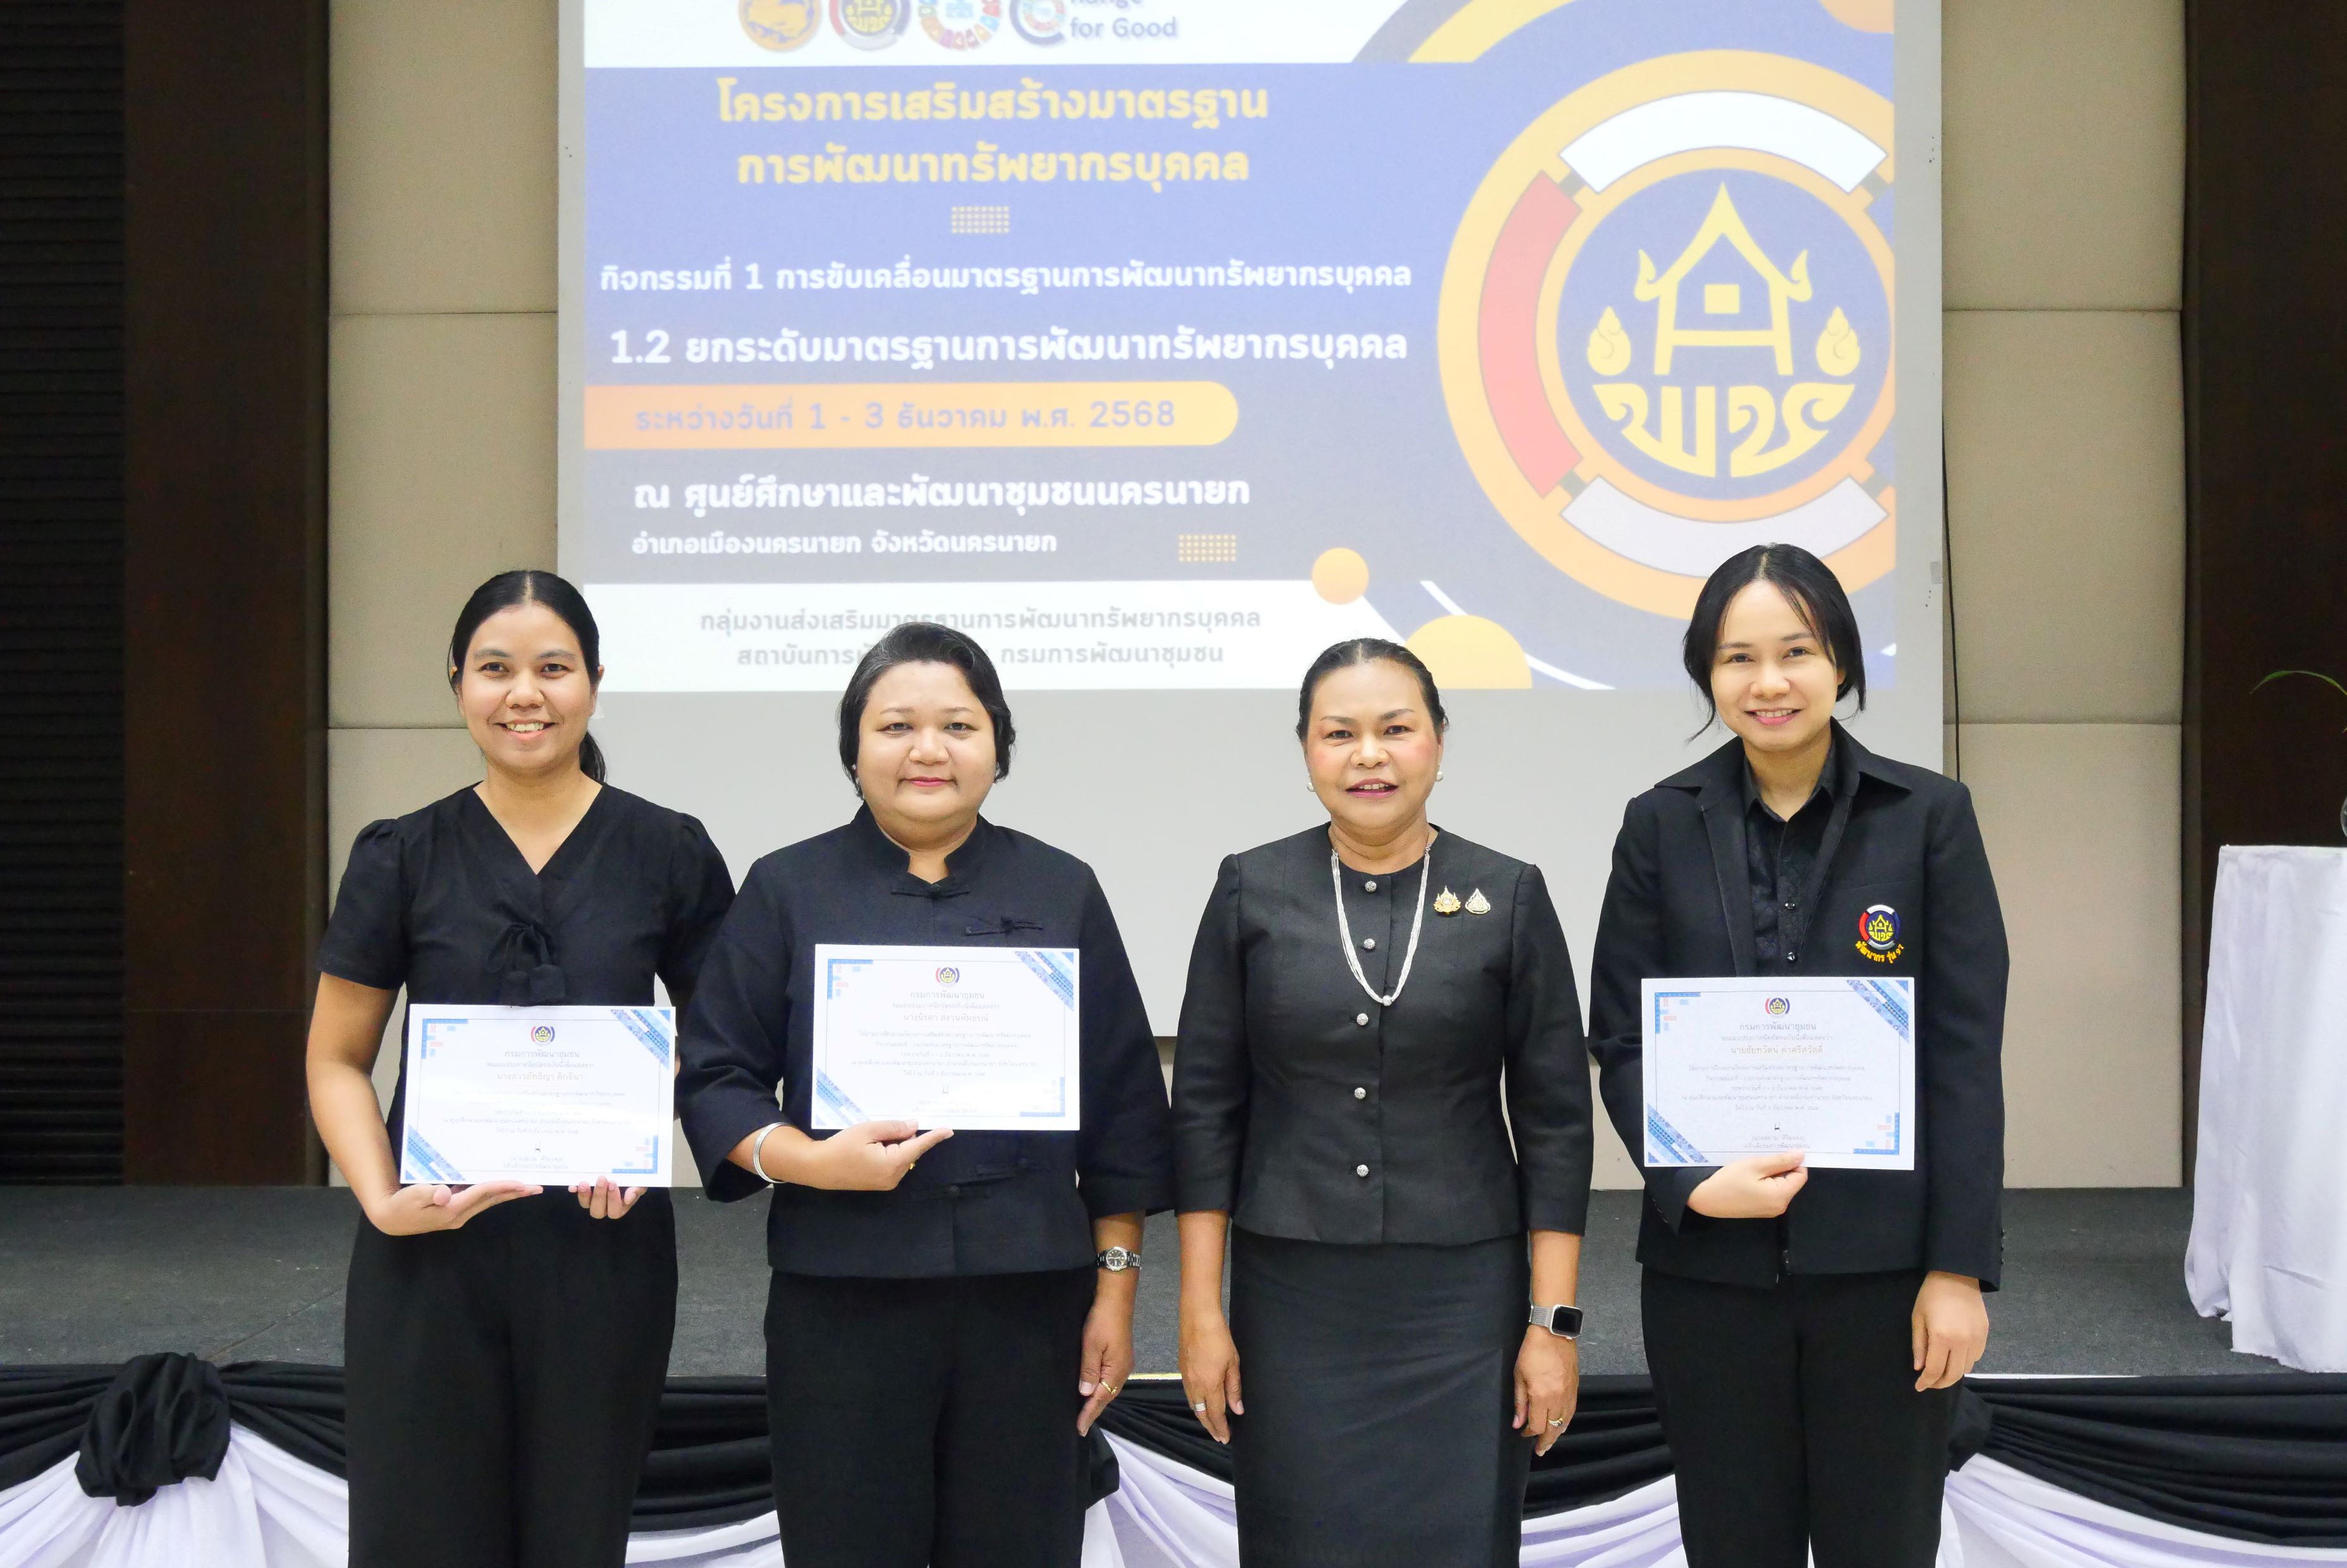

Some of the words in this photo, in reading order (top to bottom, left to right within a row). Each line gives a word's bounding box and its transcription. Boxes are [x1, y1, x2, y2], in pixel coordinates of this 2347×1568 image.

[1070, 16, 1104, 38] for
[1112, 16, 1177, 38] Good
[718, 77, 1268, 130] โครงการเสริมสร้างมาตรฐาน
[738, 141, 1249, 193] การพัฒนาทรัพยากรบุคคล
[601, 255, 733, 291] กิจกรรมที่
[745, 263, 764, 290] 1
[777, 254, 1412, 296] การขับเคลื่อนมาตรฐานการพัฒนาทรัพยากรบุคคล
[611, 329, 672, 364] 1.2
[685, 325, 1409, 371] ยกระดับมาตรฐานการพัฒนาทรัพยากรบุคคล
[635, 396, 795, 431] ระหว่างวันที่
[809, 402, 827, 431] 1
[864, 402, 885, 430] 3
[897, 401, 1008, 430] ธันวาคม
[1021, 407, 1076, 429] พ.ศ.
[1089, 400, 1177, 429] 2568
[635, 485, 671, 509] ณ
[685, 474, 1251, 518] ศูนย์ศึกษาและพัฒนาชุมชนนครนายก
[632, 530, 862, 555] อำเภอเมืองนครนายก
[871, 529, 1058, 554] จังหวัดนครนายก
[1001, 640, 1224, 670] กรมการพัฒนาชุมชน
